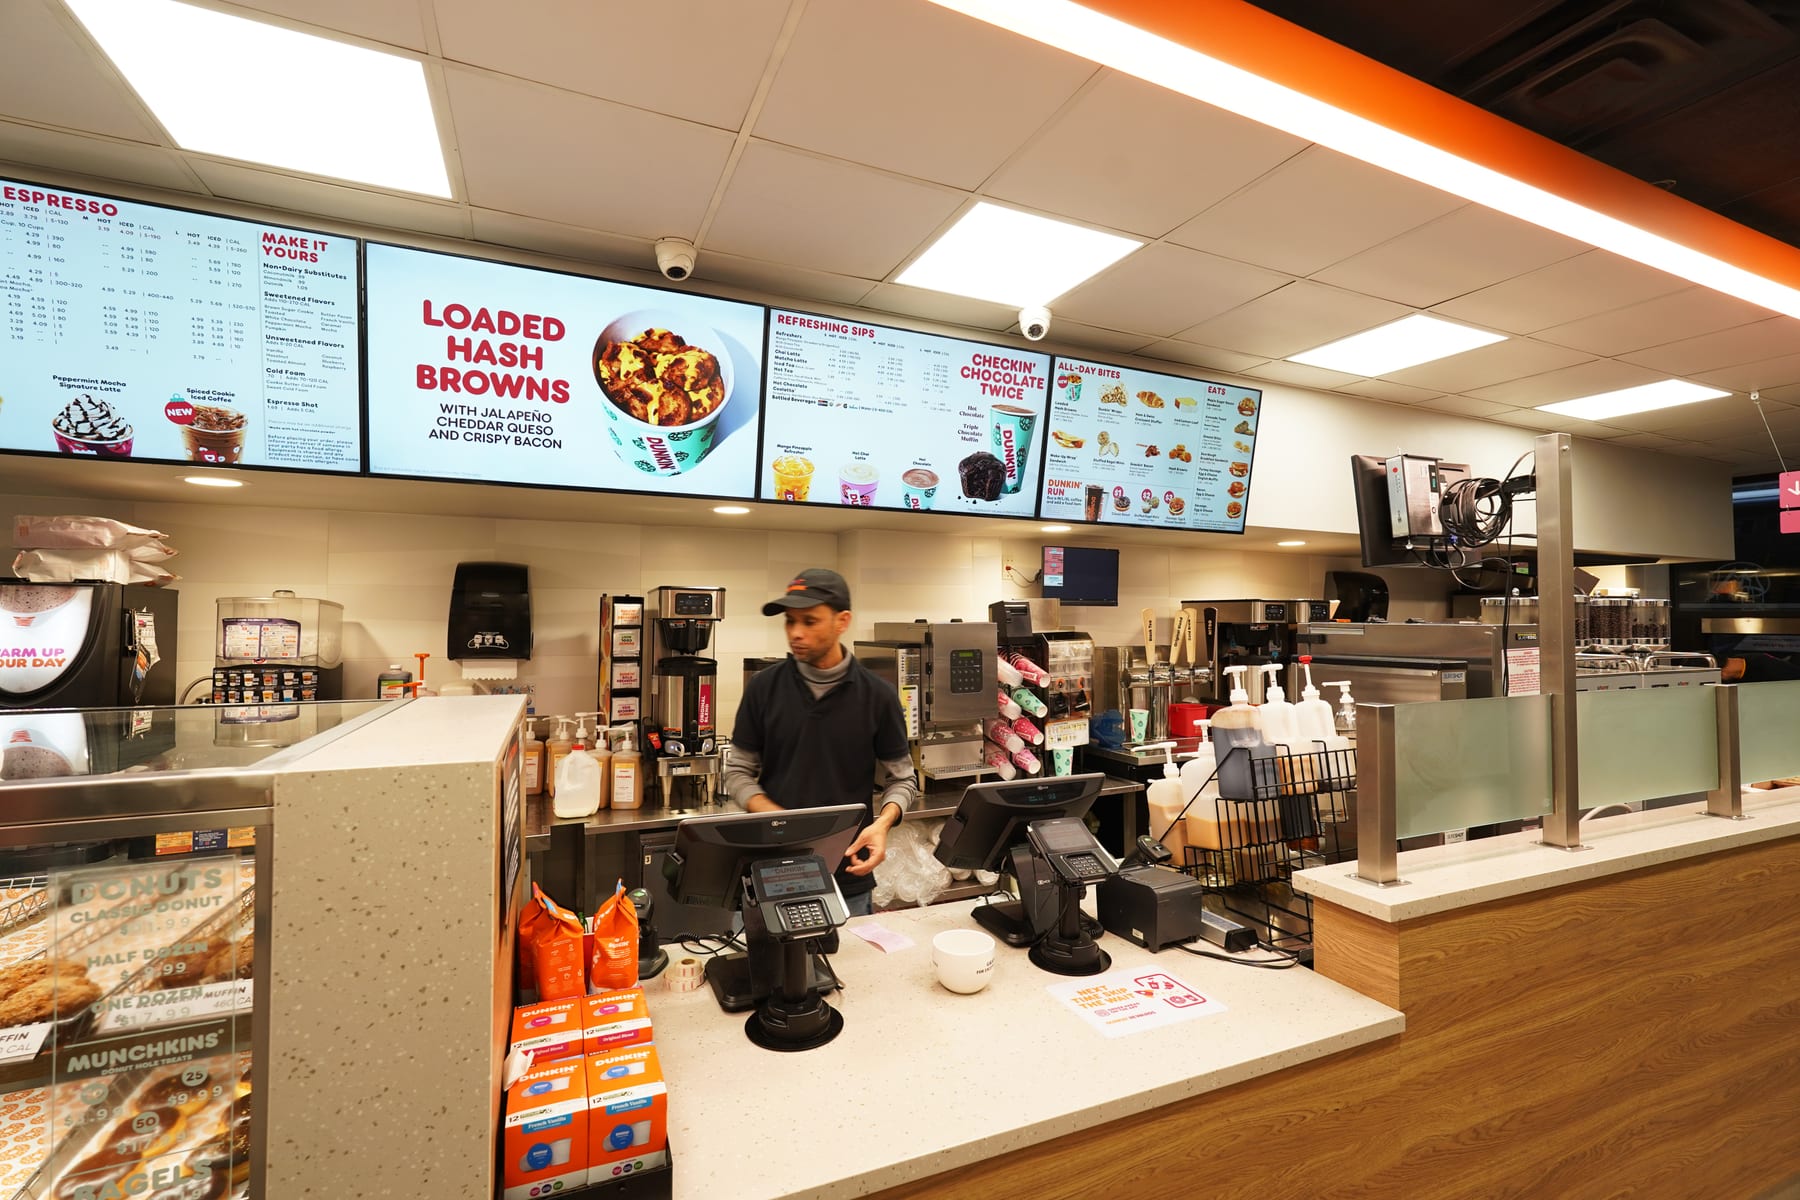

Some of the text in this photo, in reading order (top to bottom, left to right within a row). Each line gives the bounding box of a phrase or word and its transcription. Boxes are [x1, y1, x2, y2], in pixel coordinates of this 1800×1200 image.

[3, 186, 118, 217] ESPRESSO
[262, 232, 328, 252] MAKE IT
[262, 244, 319, 263] YOURS
[304, 268, 347, 280] Substitutes
[264, 291, 335, 306] Sweetened Flavors
[423, 299, 566, 342] LOADED
[777, 314, 849, 334] REFRESHING
[851, 326, 875, 338] SIPS
[265, 334, 345, 349] Unsweetened Flavors
[775, 331, 802, 339] Refreshers
[447, 335, 543, 371] HASH
[972, 353, 1037, 375] CHECKIN'
[1058, 361, 1121, 379] ALL-DAY BITES
[265, 367, 306, 377] Cold Foam
[960, 366, 1045, 390] CHOCOLATE
[52, 374, 127, 388] Peppermint Mocha
[59, 382, 121, 393] Signature Latte
[416, 364, 570, 404] BROWNS
[186, 387, 236, 398] Spiced Cookie
[980, 382, 1025, 400] TWICE
[1207, 385, 1226, 396] EATS
[207, 395, 232, 404] Coffee
[266, 398, 300, 407] Espresso
[166, 407, 193, 417] NEW
[440, 403, 552, 423] WITH JALAPEÑO
[959, 411, 985, 419] Chocolate
[436, 416, 554, 436] CHEDDAR QUESO
[957, 429, 983, 437] Chocolate
[428, 429, 562, 449] AND CRISPY BACON
[1002, 429, 1017, 480] DUNKIN'
[1047, 478, 1083, 489] DUNKIN'
[1047, 487, 1065, 496] RUN
[0, 648, 65, 657] ARM UP
[31, 658, 66, 668] DAY
[70, 867, 223, 905] DONUTS
[69, 895, 223, 925] CLASSIC DONUT
[87, 941, 209, 969] HALF DOZEN
[1071, 988, 1128, 1004] TIME SKIP
[1076, 985, 1109, 996] NEXT
[90, 997, 133, 1015] ONE
[137, 986, 203, 1005] DOZEN
[238, 996, 252, 1005] CA
[589, 993, 640, 1006] DUNKIN'
[1077, 993, 1136, 1009] THE WAIT
[521, 1003, 575, 1018] DUNKIN'
[602, 1031, 635, 1043] Original Blend
[101, 1054, 193, 1076] DONUT HOLE TREATS
[595, 1051, 651, 1067] DUNKIN'
[185, 1071, 203, 1082] 25
[518, 1064, 579, 1083] DUNKIN'
[592, 1097, 602, 1105] 12
[611, 1098, 648, 1111] French Vanilla
[136, 1116, 155, 1129] 50
[508, 1115, 520, 1124] 12
[528, 1116, 567, 1131] French Vanilla
[73, 1158, 212, 1200] BAGELS
